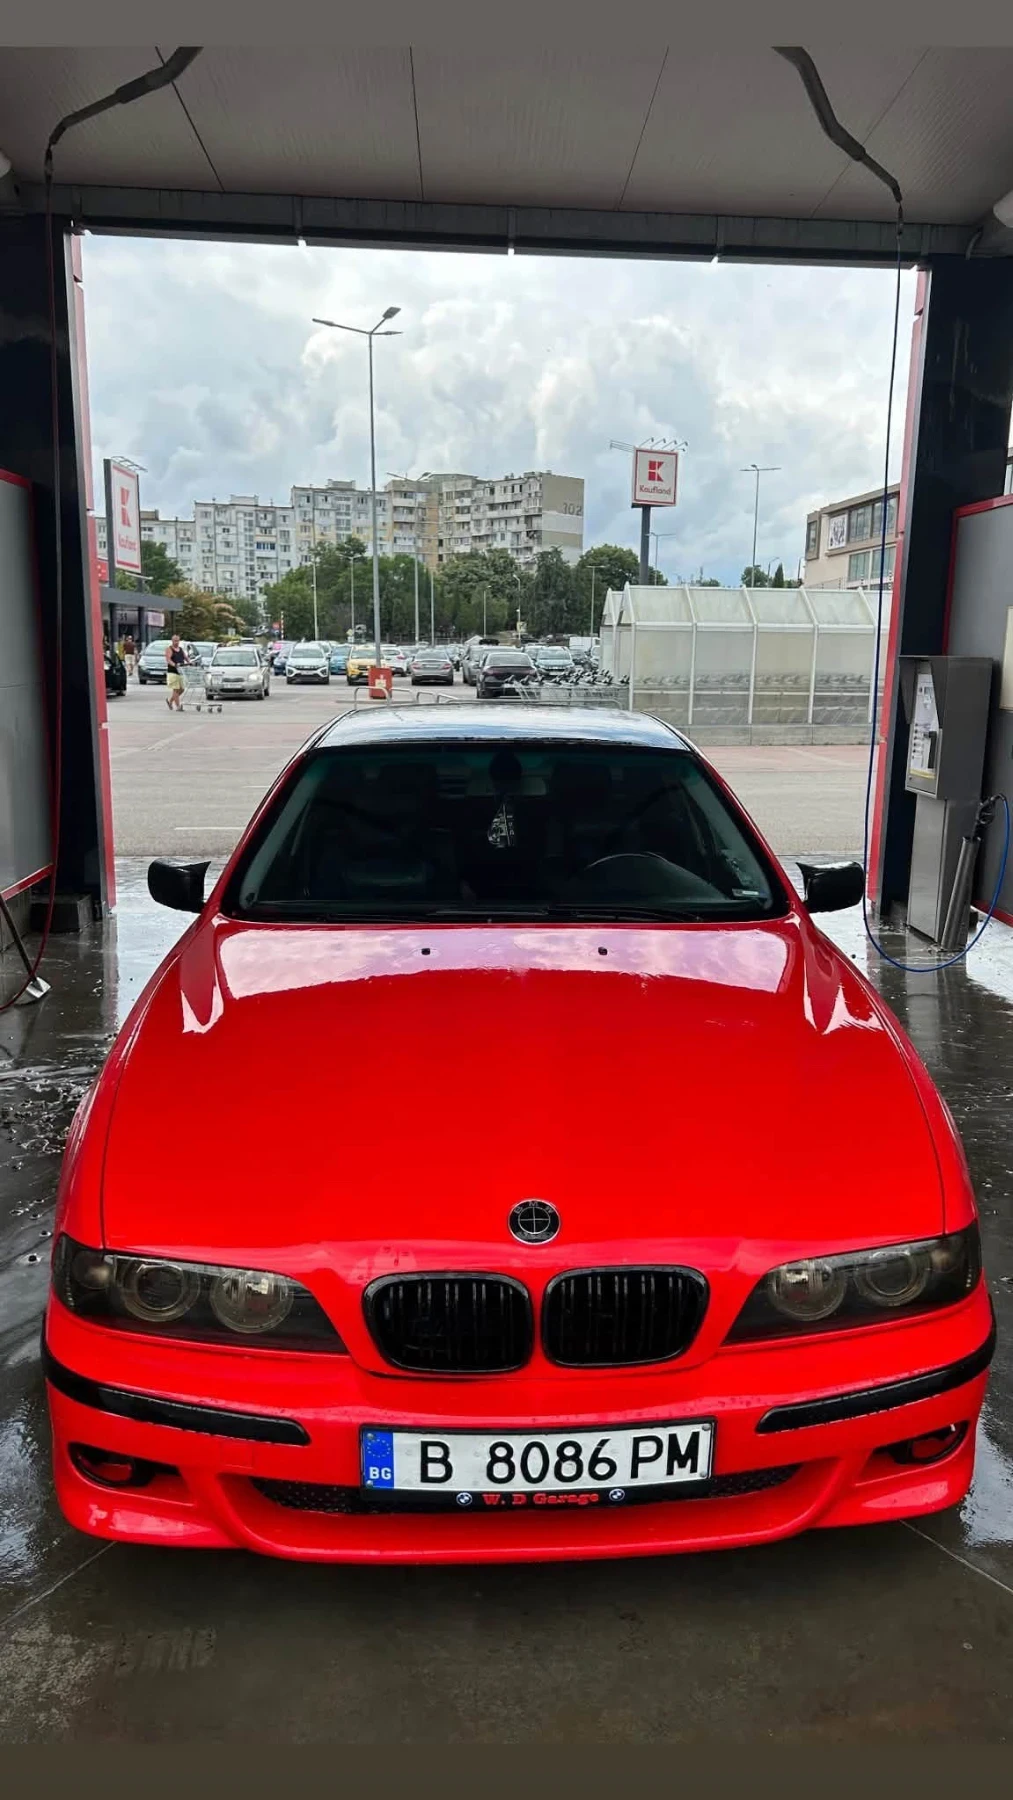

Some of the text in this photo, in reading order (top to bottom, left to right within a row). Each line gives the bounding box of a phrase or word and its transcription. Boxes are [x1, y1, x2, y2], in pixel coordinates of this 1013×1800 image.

[639, 484, 672, 495] Kaufland
[420, 1431, 700, 1484] B 8086 PM
[369, 1466, 392, 1480] BG
[482, 1493, 599, 1506] W. D Garage
